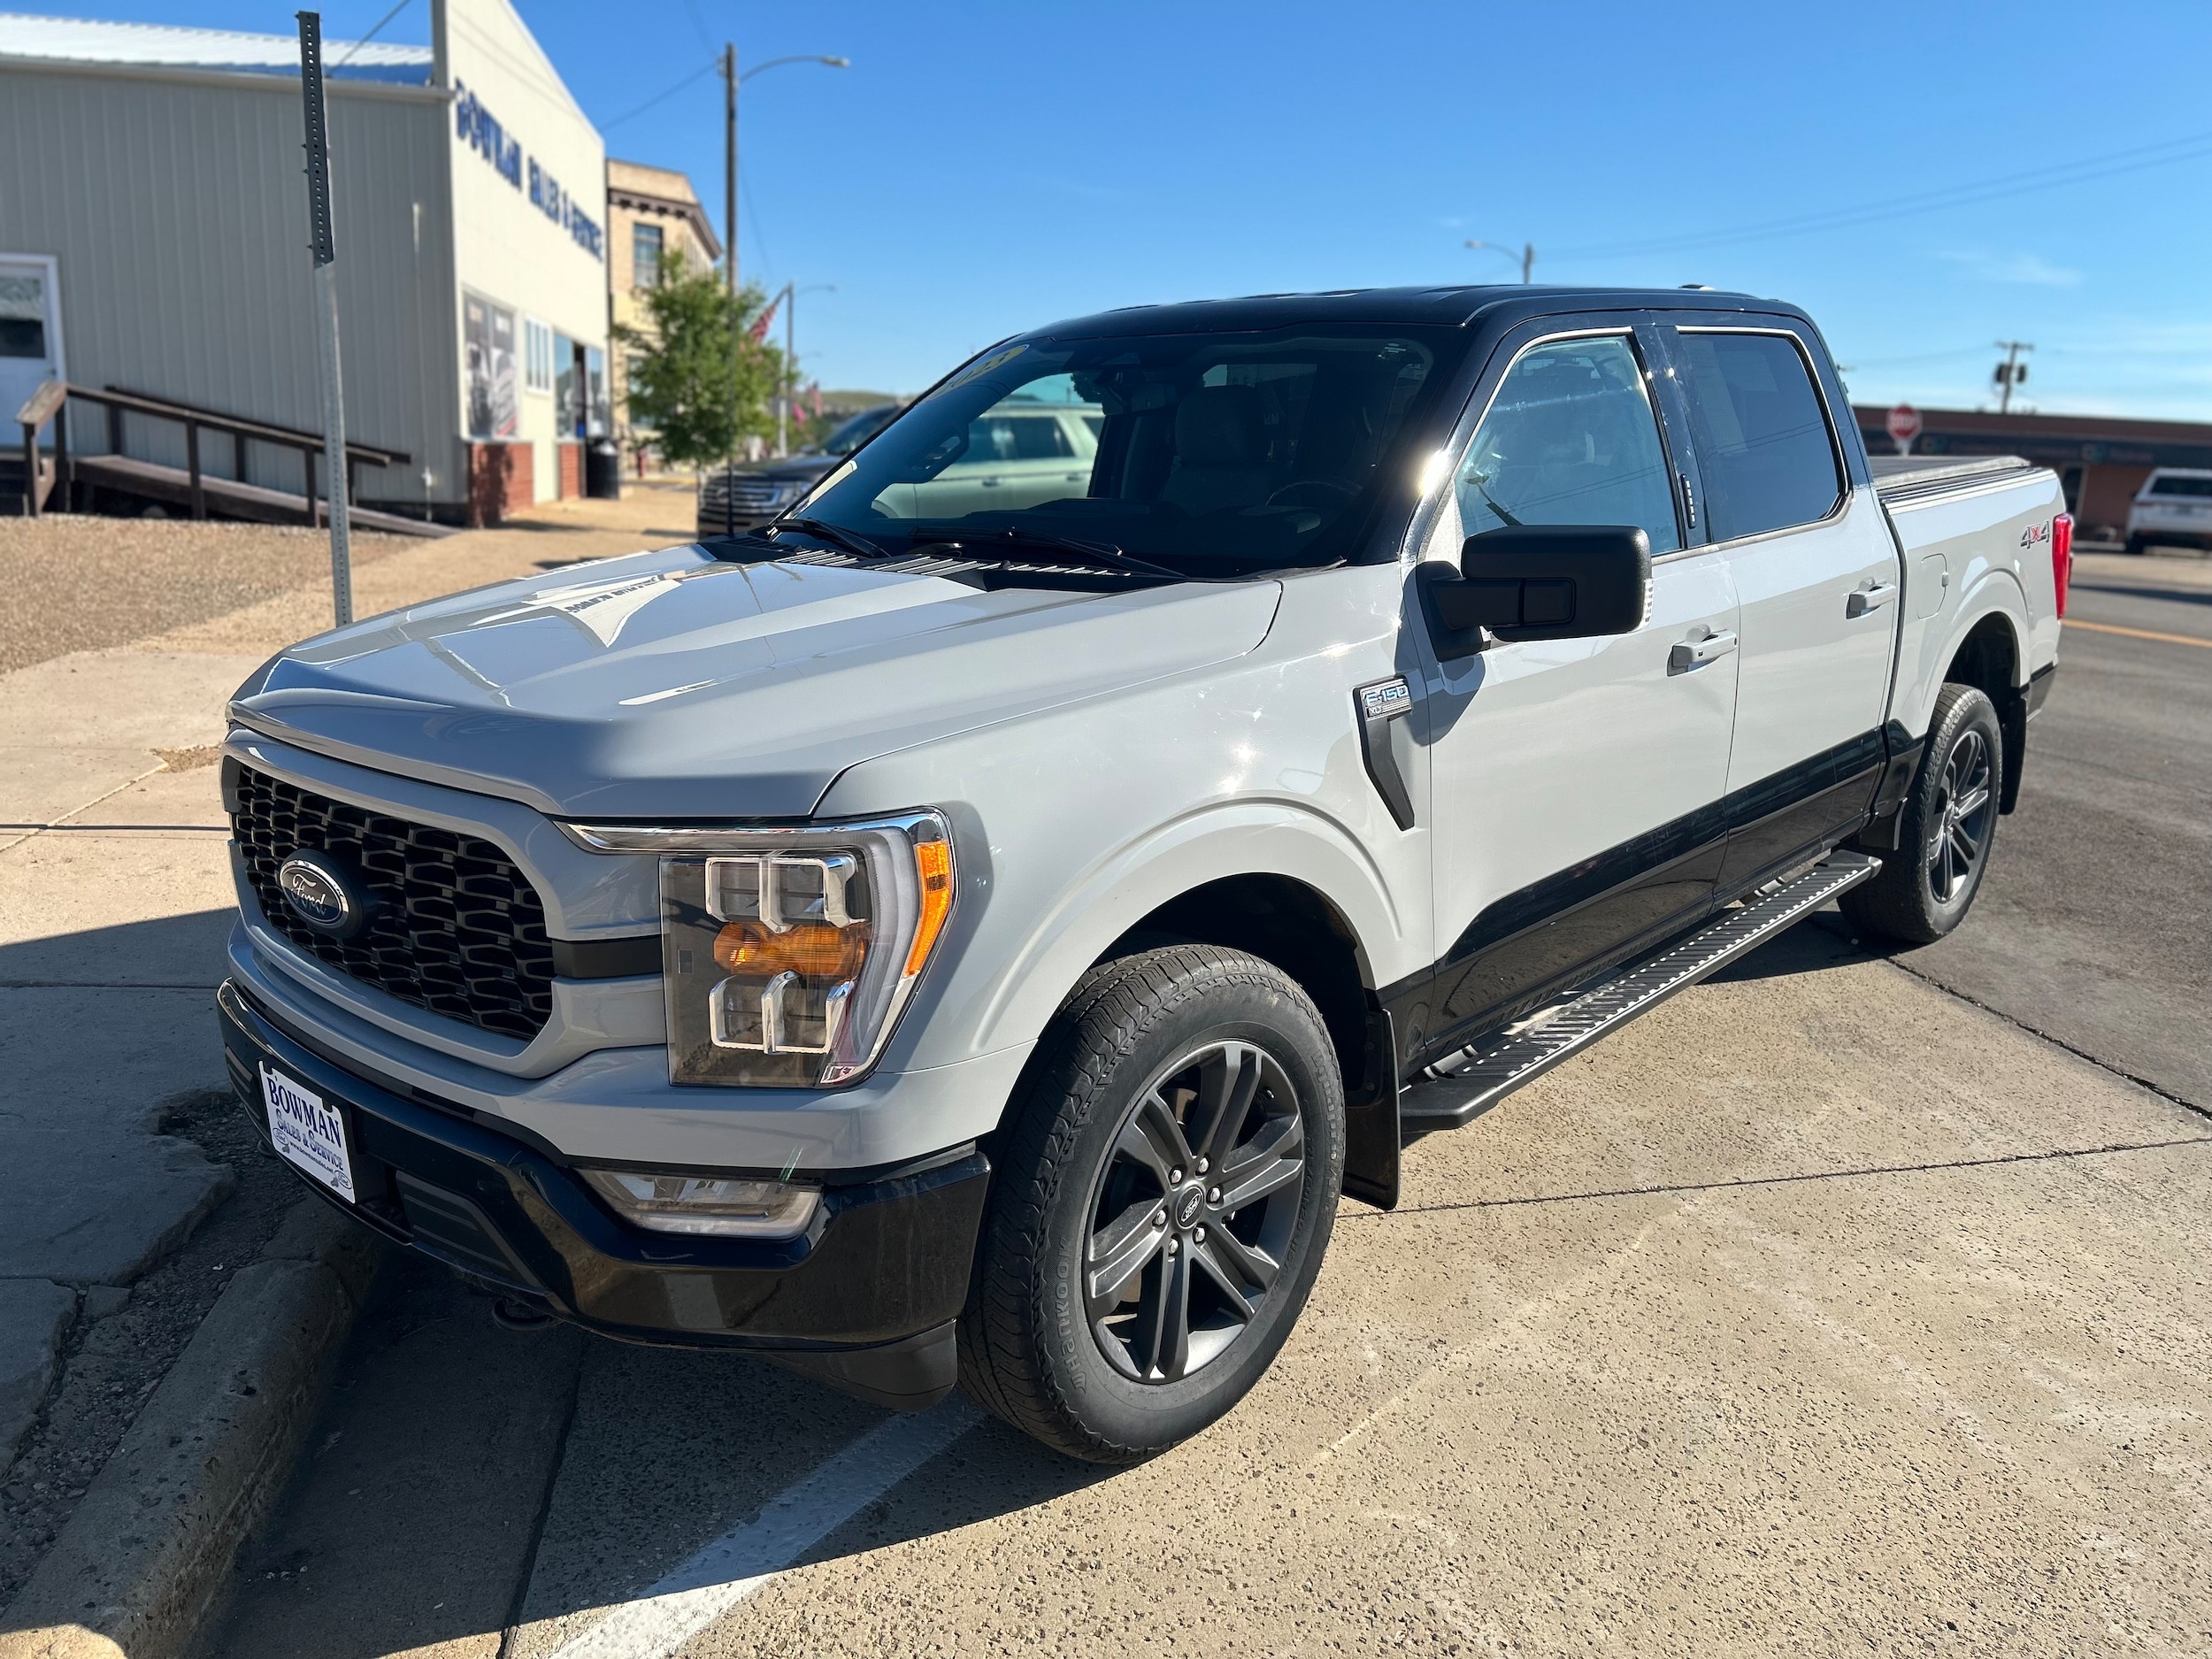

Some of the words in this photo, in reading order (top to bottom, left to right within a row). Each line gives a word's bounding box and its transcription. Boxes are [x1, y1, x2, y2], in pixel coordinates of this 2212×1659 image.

[1891, 414, 1918, 427] STOP
[1365, 685, 1409, 707] F-150
[291, 873, 326, 916] Ford
[267, 1077, 342, 1148] BOWMAN
